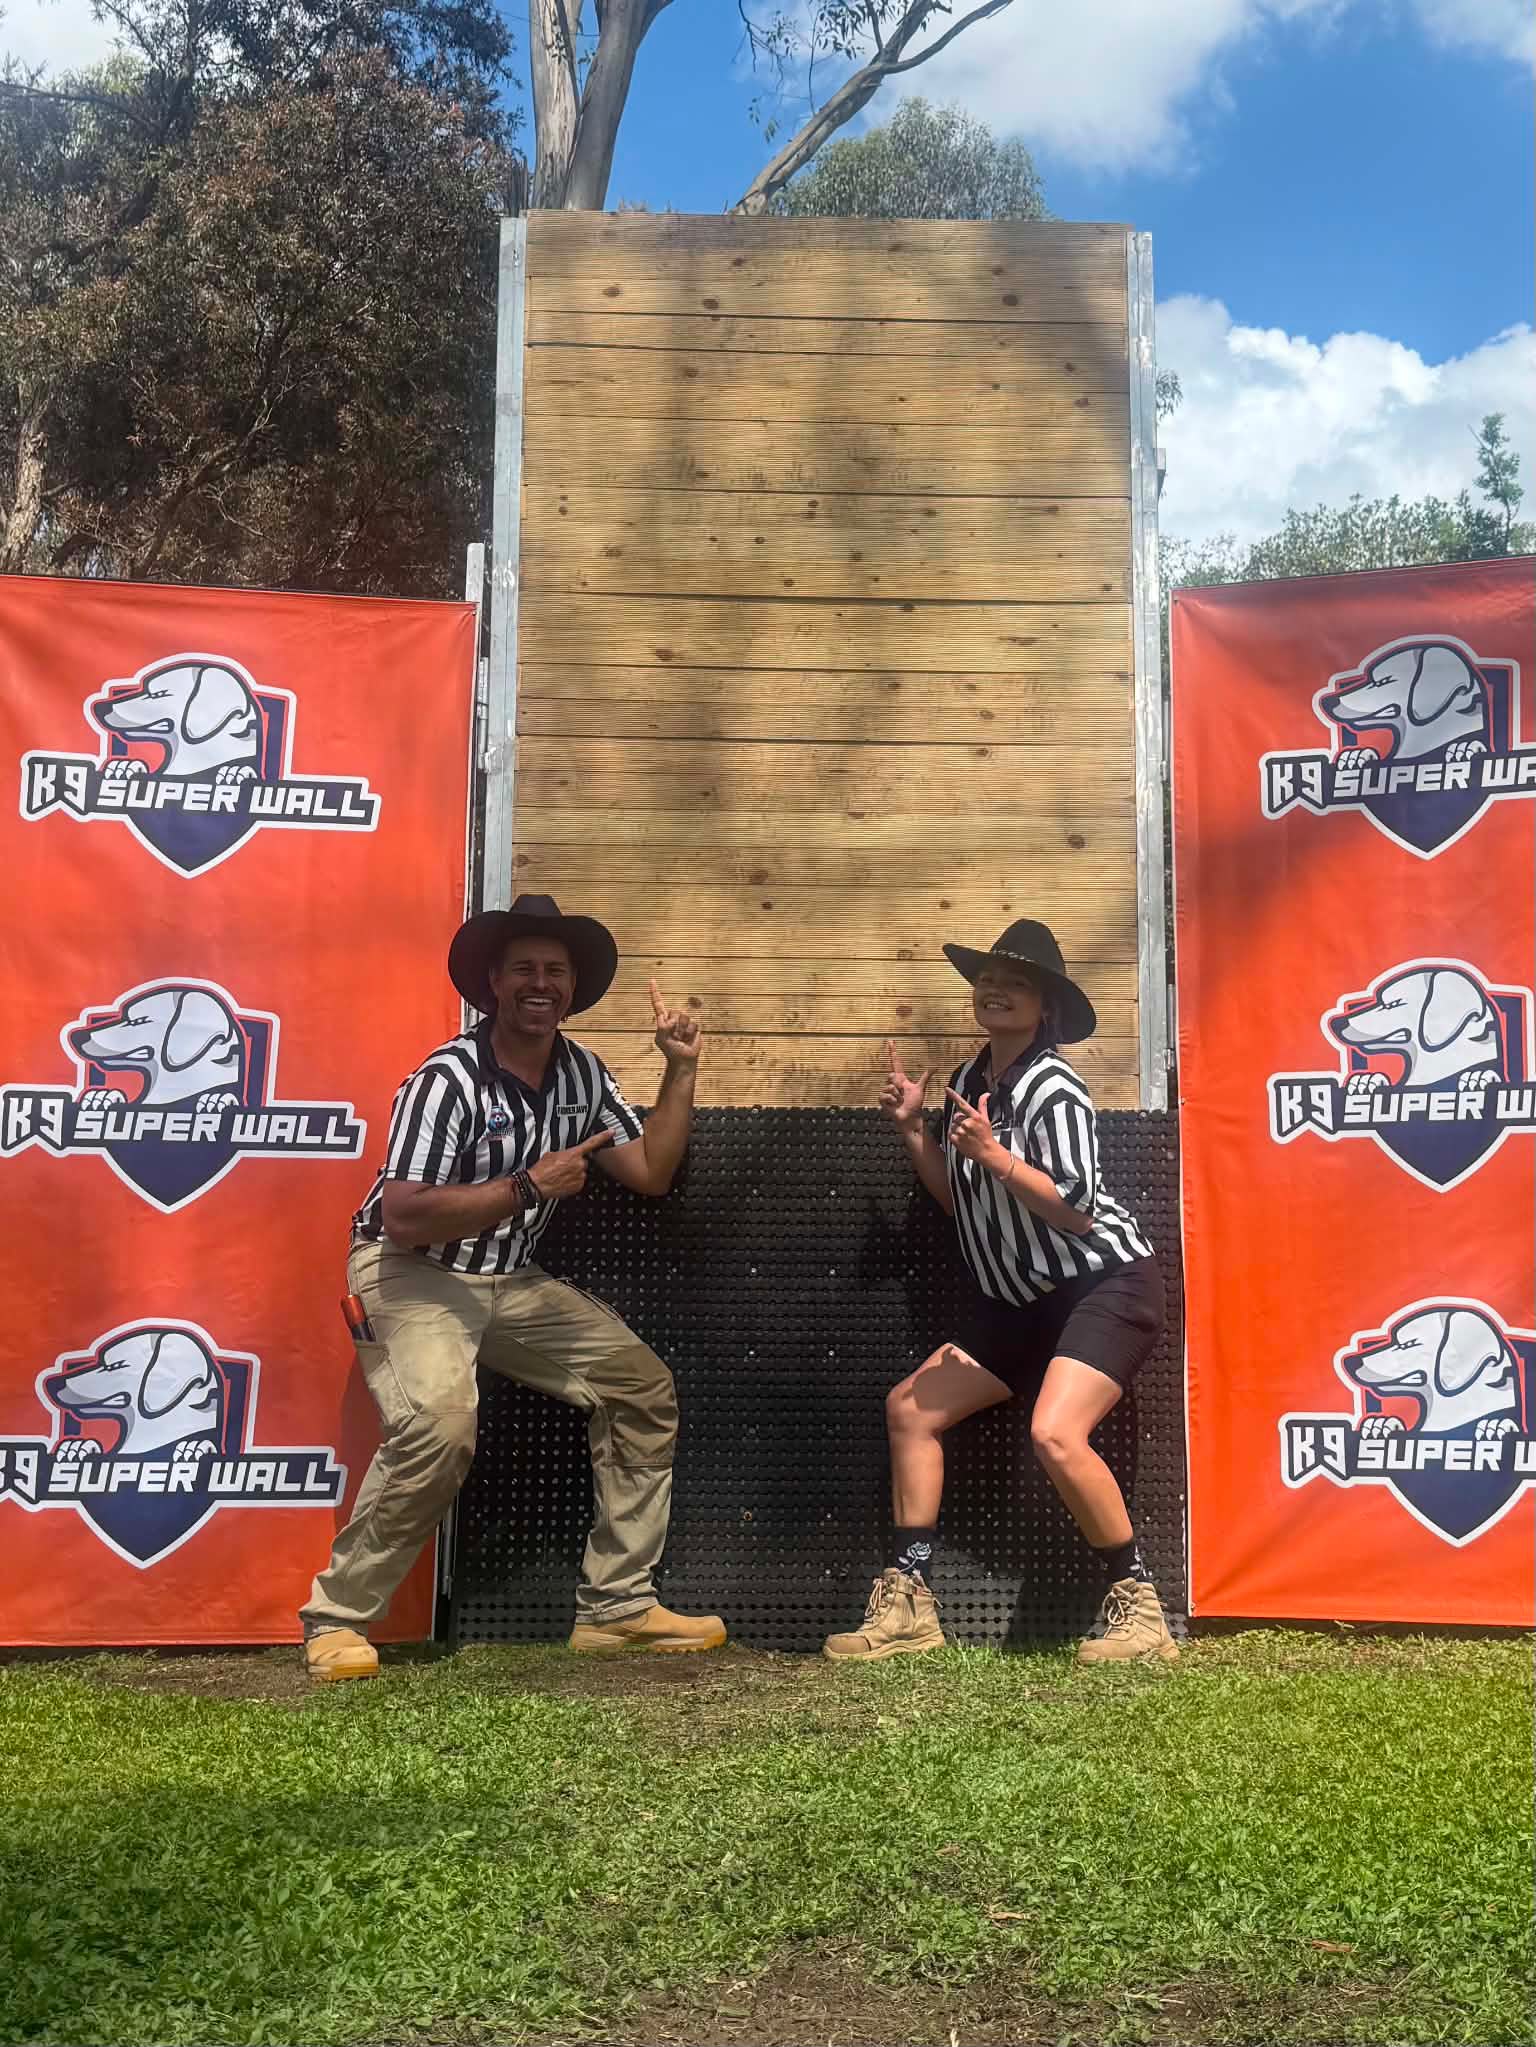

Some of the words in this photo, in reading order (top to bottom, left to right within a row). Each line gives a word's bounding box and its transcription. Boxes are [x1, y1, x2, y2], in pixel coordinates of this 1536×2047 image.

[31, 763, 87, 814] K9
[97, 779, 239, 812] SUPER
[250, 786, 366, 817] WALL
[1270, 762, 1324, 809] K9
[1333, 761, 1471, 798] SUPER
[8, 1097, 64, 1147] K9
[74, 1110, 217, 1142] SUPER
[230, 1114, 354, 1144] WALL
[1281, 1083, 1336, 1130] K9
[1343, 1090, 1485, 1121] SUPER
[1292, 1426, 1346, 1477] K9
[1357, 1440, 1503, 1470] SUPER
[48, 1462, 199, 1492] SUPER
[208, 1462, 330, 1492] WALL
